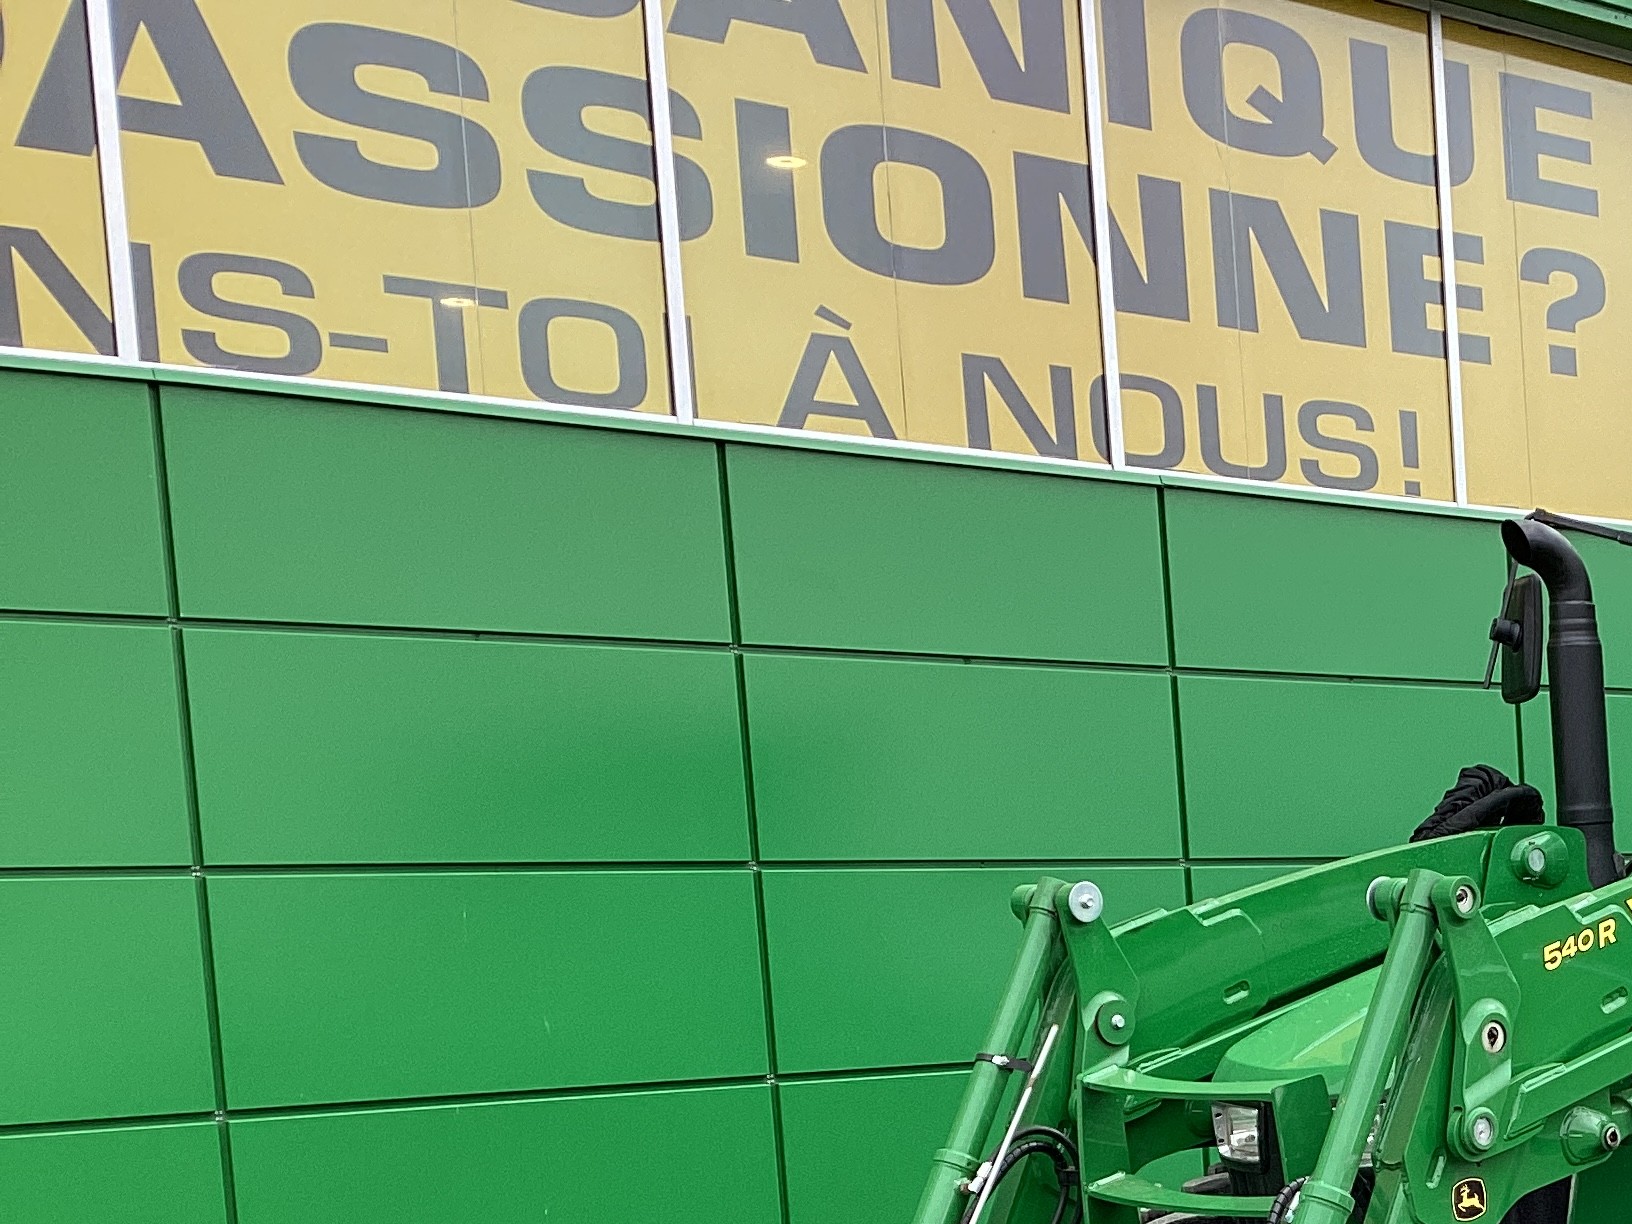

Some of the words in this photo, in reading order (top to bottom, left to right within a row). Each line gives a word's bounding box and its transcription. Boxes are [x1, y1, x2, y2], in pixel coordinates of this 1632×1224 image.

[0, 0, 1607, 378] ASSIONNE?
[776, 305, 897, 440] À
[961, 353, 1421, 498] NOUS!
[1543, 927, 1595, 971] 540
[1598, 918, 1617, 949] R
